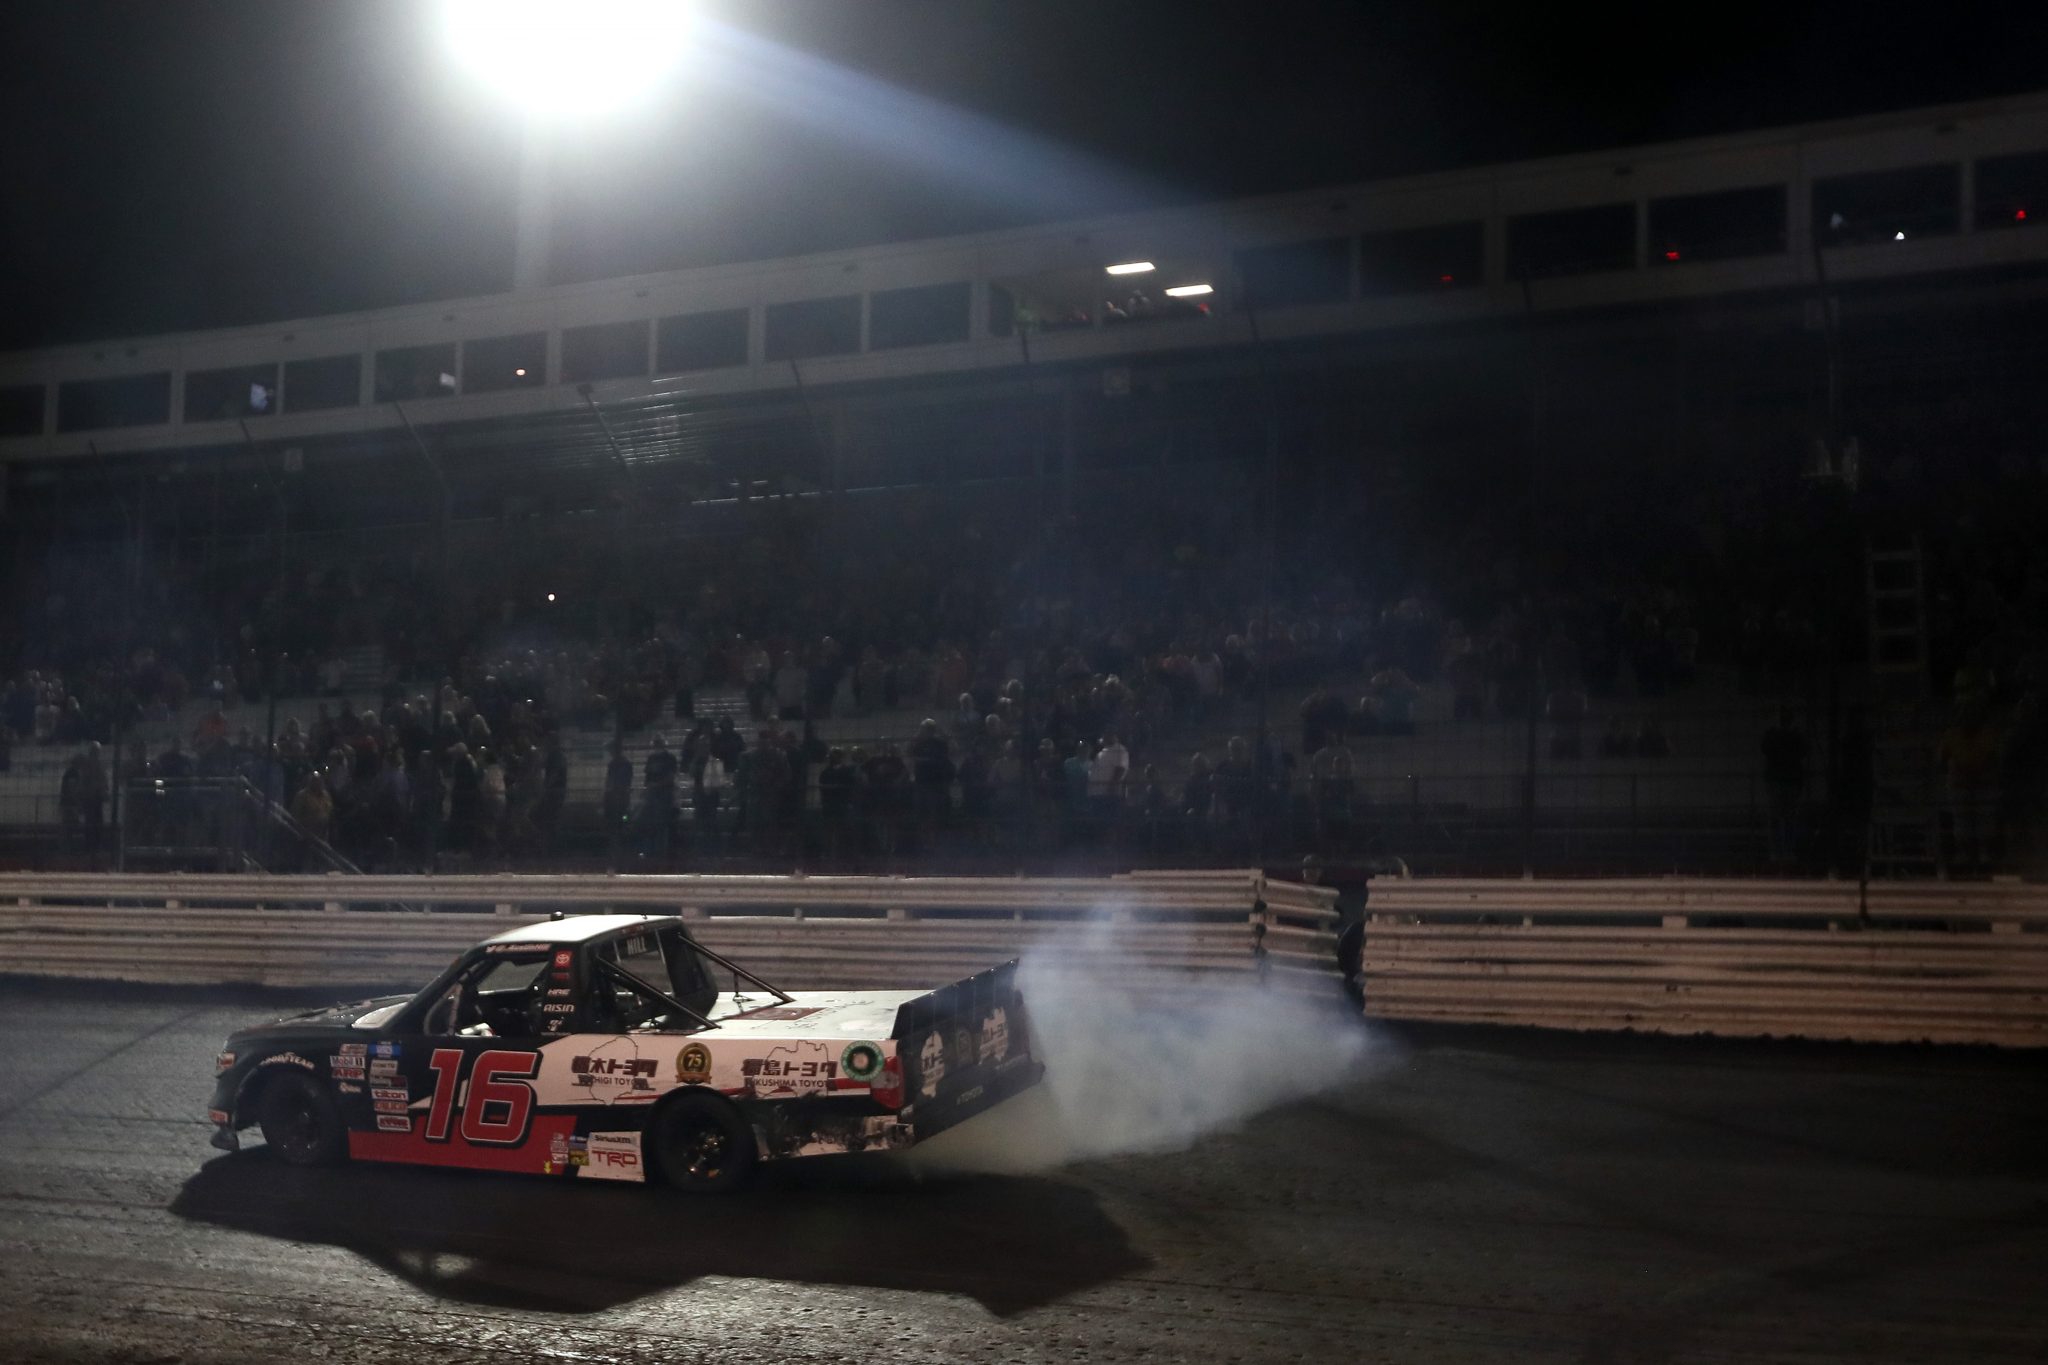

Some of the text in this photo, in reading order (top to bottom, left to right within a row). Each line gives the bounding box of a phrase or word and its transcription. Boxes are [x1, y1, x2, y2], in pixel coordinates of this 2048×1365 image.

[543, 1003, 575, 1012] AISIN
[687, 1053, 702, 1067] 75
[425, 1047, 539, 1143] 16
[592, 1149, 637, 1168] TRD
